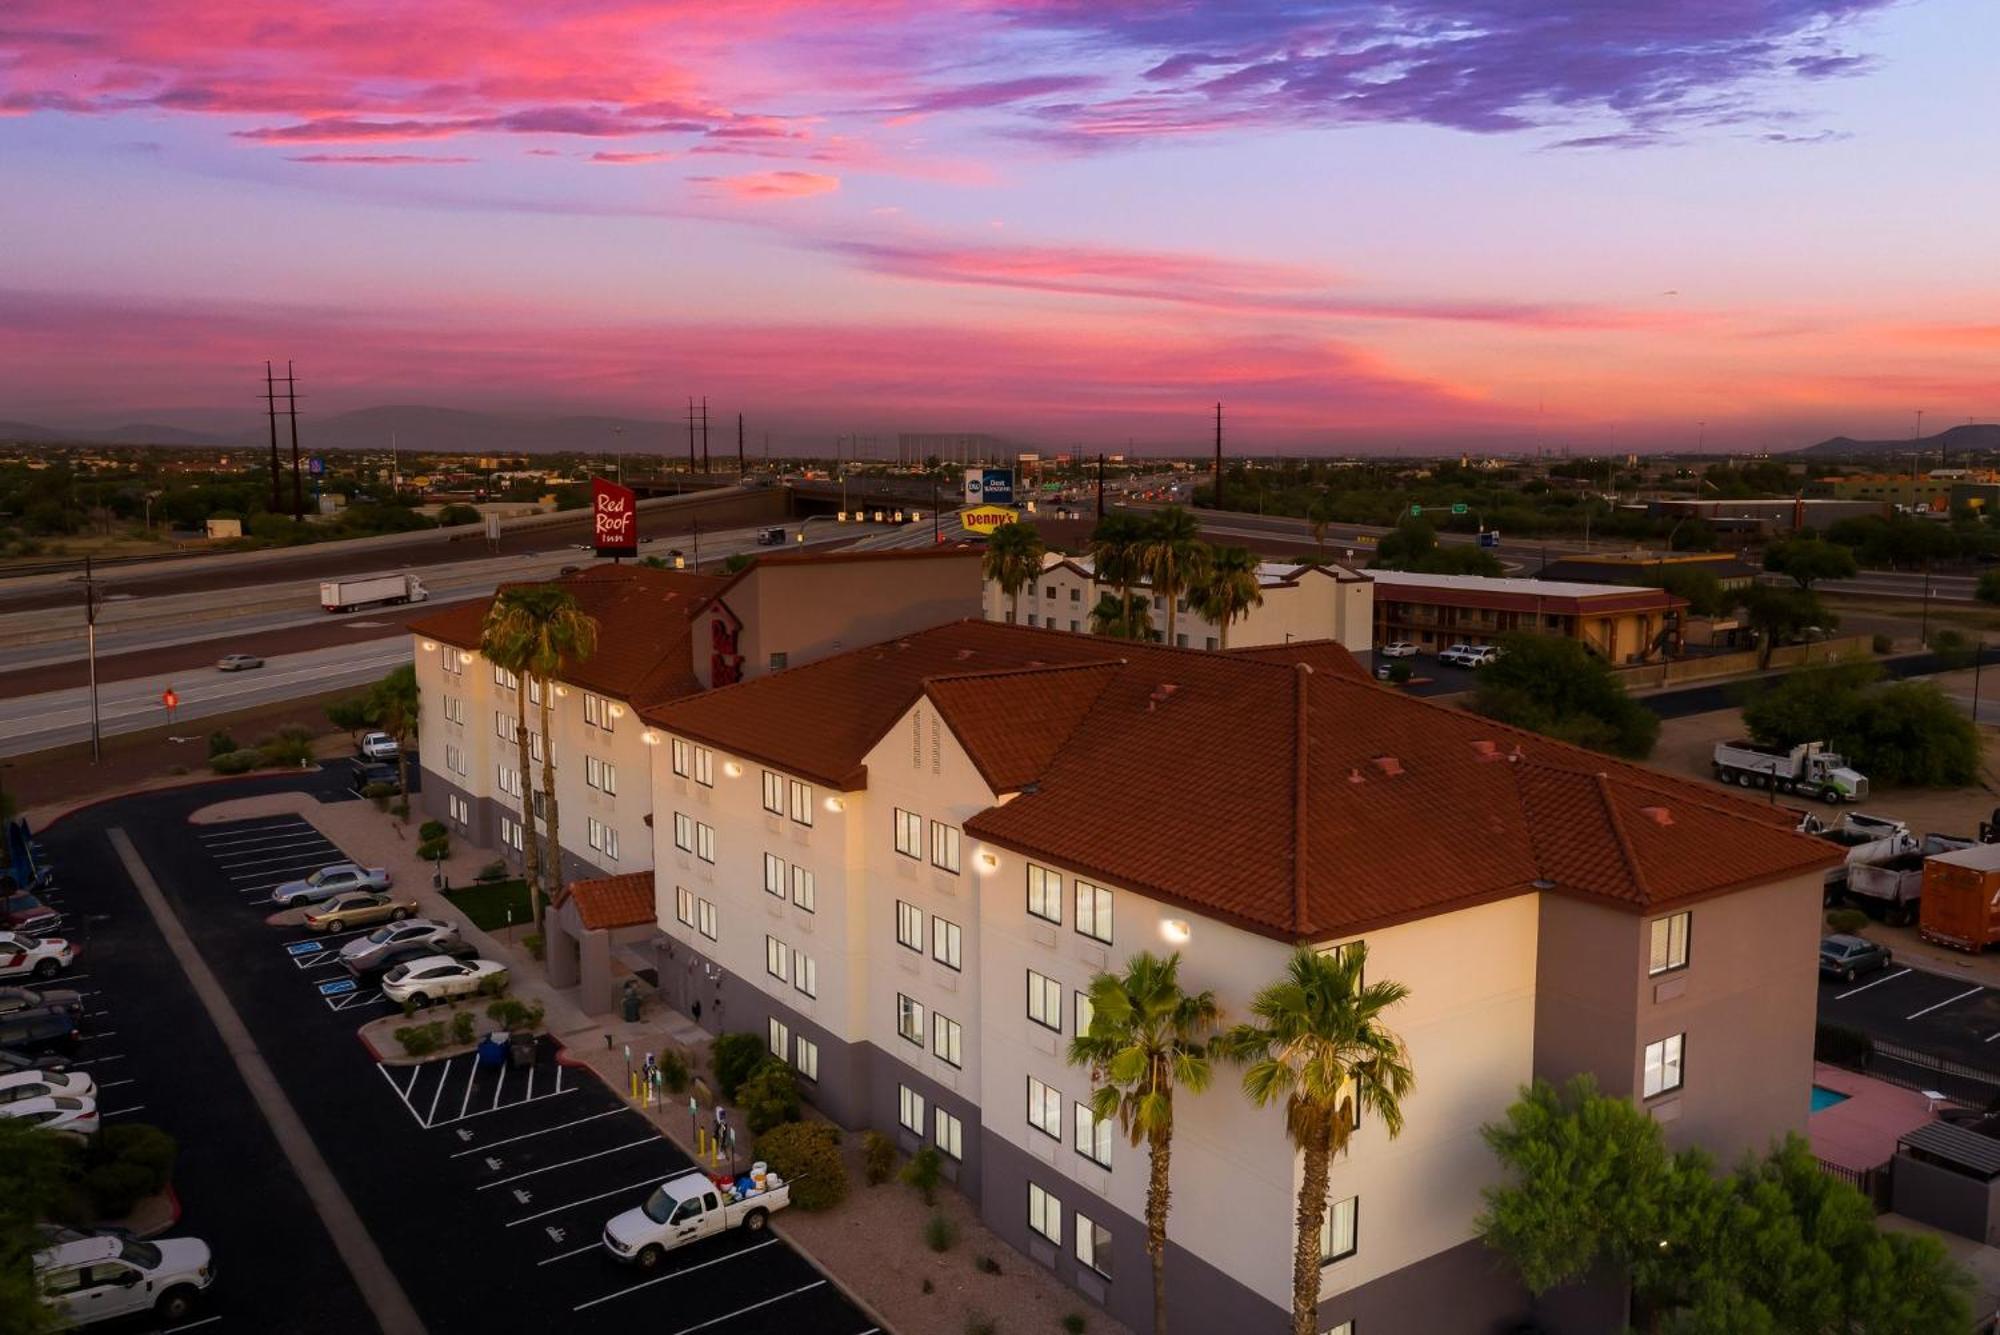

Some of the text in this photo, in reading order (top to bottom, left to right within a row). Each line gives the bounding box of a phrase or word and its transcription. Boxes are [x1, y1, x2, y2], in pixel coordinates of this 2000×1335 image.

[597, 493, 625, 513] Red
[596, 511, 633, 534] Roof
[966, 512, 1014, 526] Denny's
